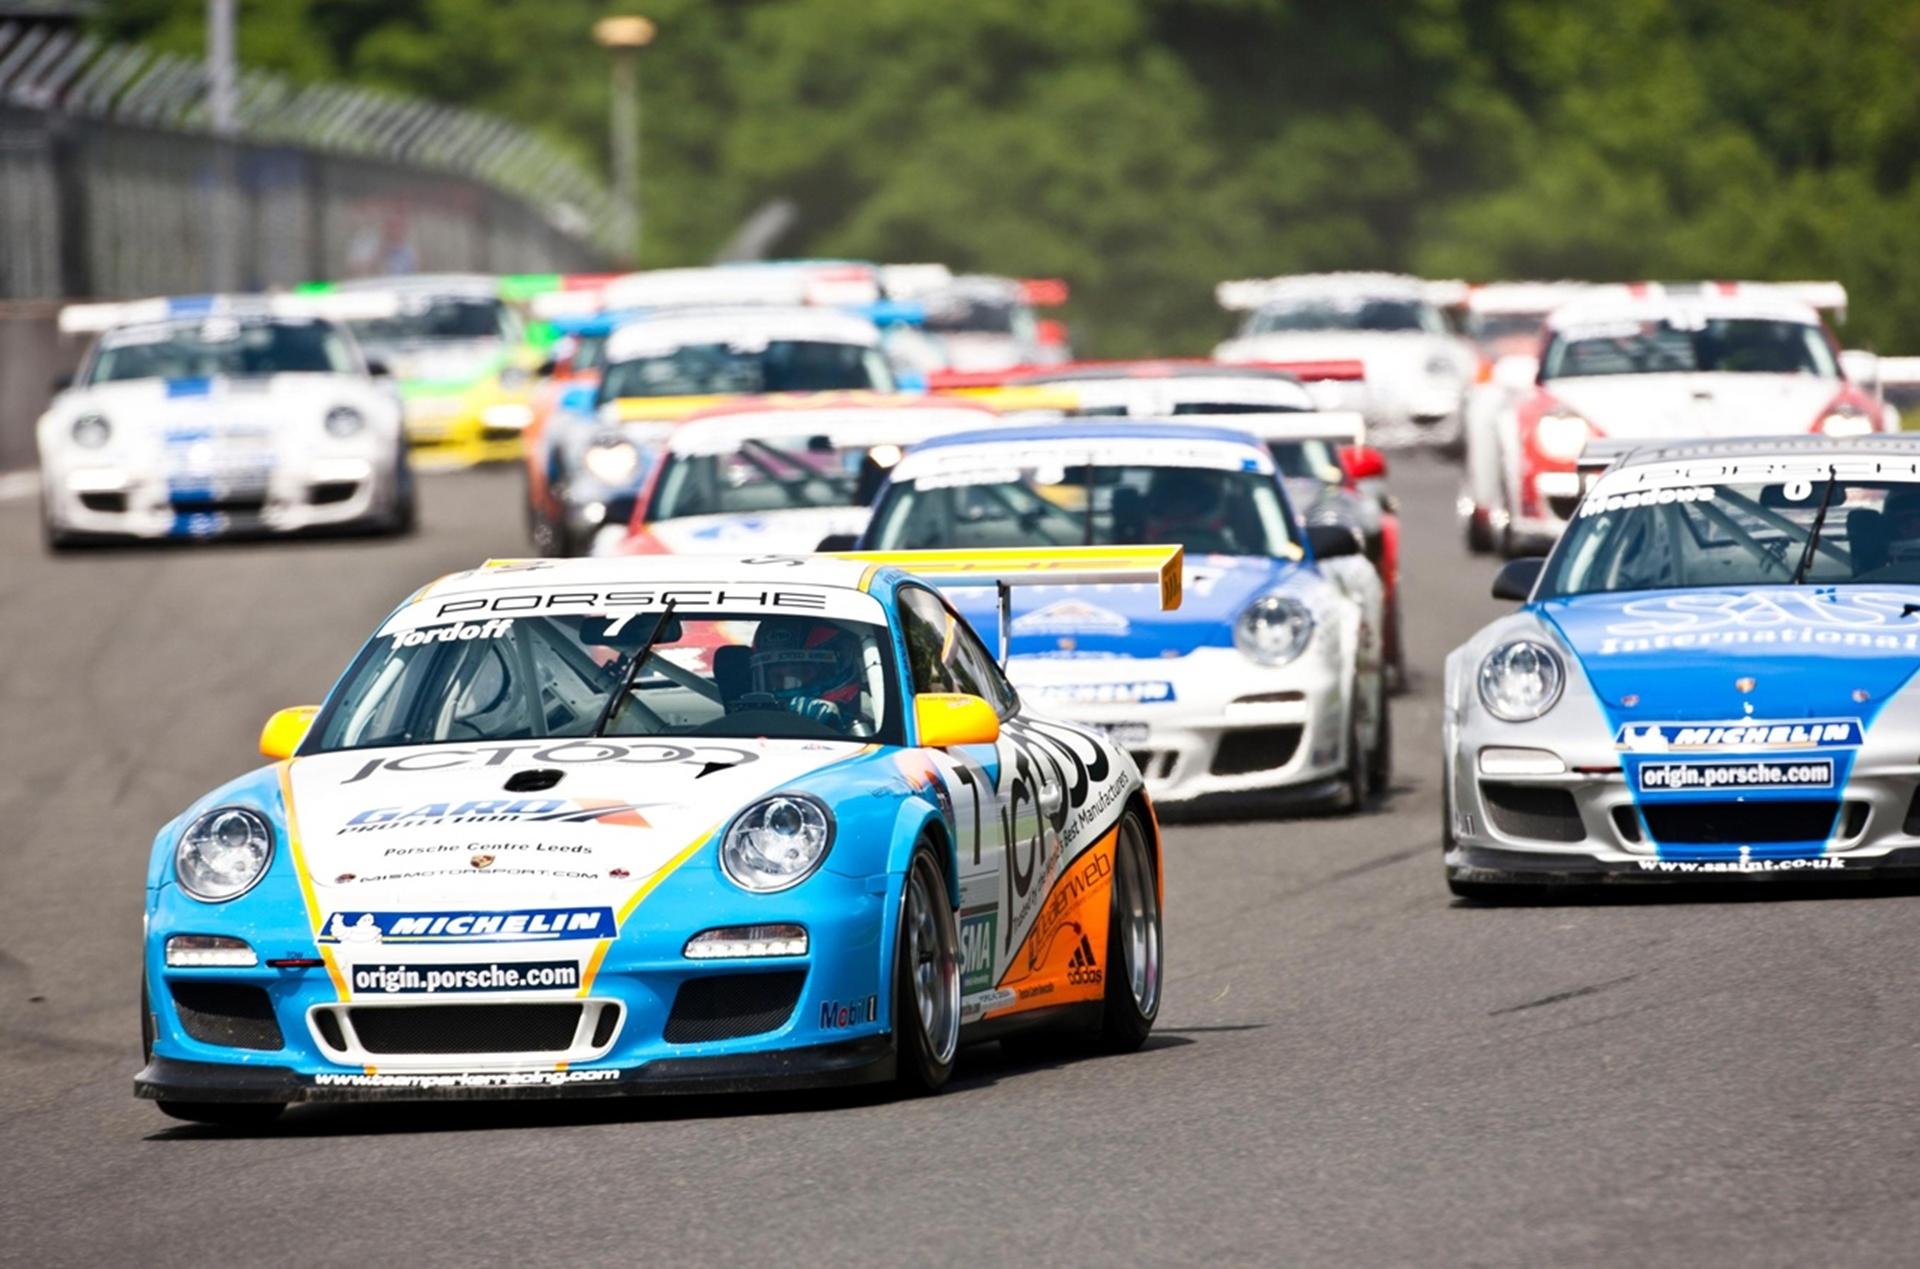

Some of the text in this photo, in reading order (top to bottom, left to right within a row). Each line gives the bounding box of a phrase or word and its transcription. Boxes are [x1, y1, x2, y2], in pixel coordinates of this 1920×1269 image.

[1580, 486, 1715, 517] Meadows
[1783, 478, 1811, 501] 0
[437, 591, 826, 617] PORSCHE
[391, 618, 514, 650] Tordoff
[603, 611, 642, 637] 7
[1599, 626, 1918, 655] International
[1674, 724, 1849, 745] MICHELIN
[340, 741, 760, 785] JCT600
[1644, 764, 1829, 787] origin.porsche.com
[1078, 770, 1130, 827] Manufacturers
[345, 799, 566, 827] GARD
[384, 842, 592, 857] Porsche Centre Leeds
[389, 912, 601, 935] MICHELIN
[356, 965, 576, 992] origin.porsche.com
